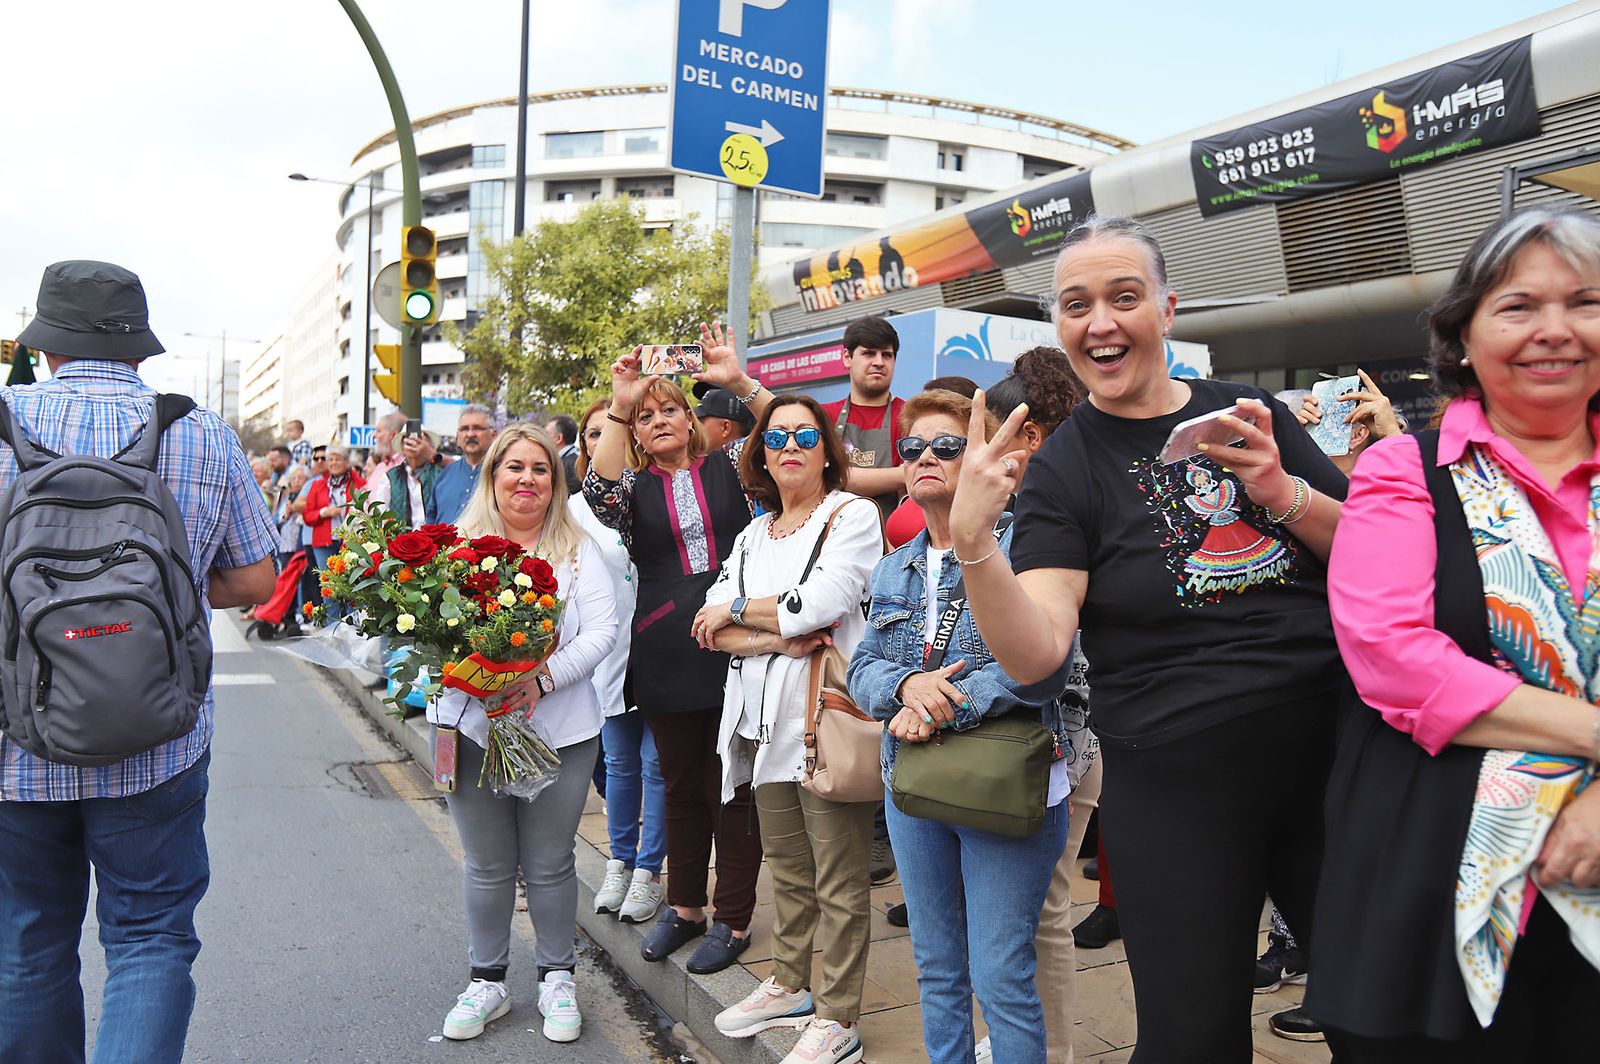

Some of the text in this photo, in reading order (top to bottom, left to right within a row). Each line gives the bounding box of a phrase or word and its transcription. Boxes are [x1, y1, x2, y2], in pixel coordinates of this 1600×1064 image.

[700, 40, 803, 79] MERCADO
[682, 64, 818, 111] DEL CARMEN
[1415, 104, 1505, 140] energía
[1215, 126, 1314, 167] 959 823 823
[1219, 146, 1315, 185] 681 913 617
[933, 598, 964, 651] BIMBA
